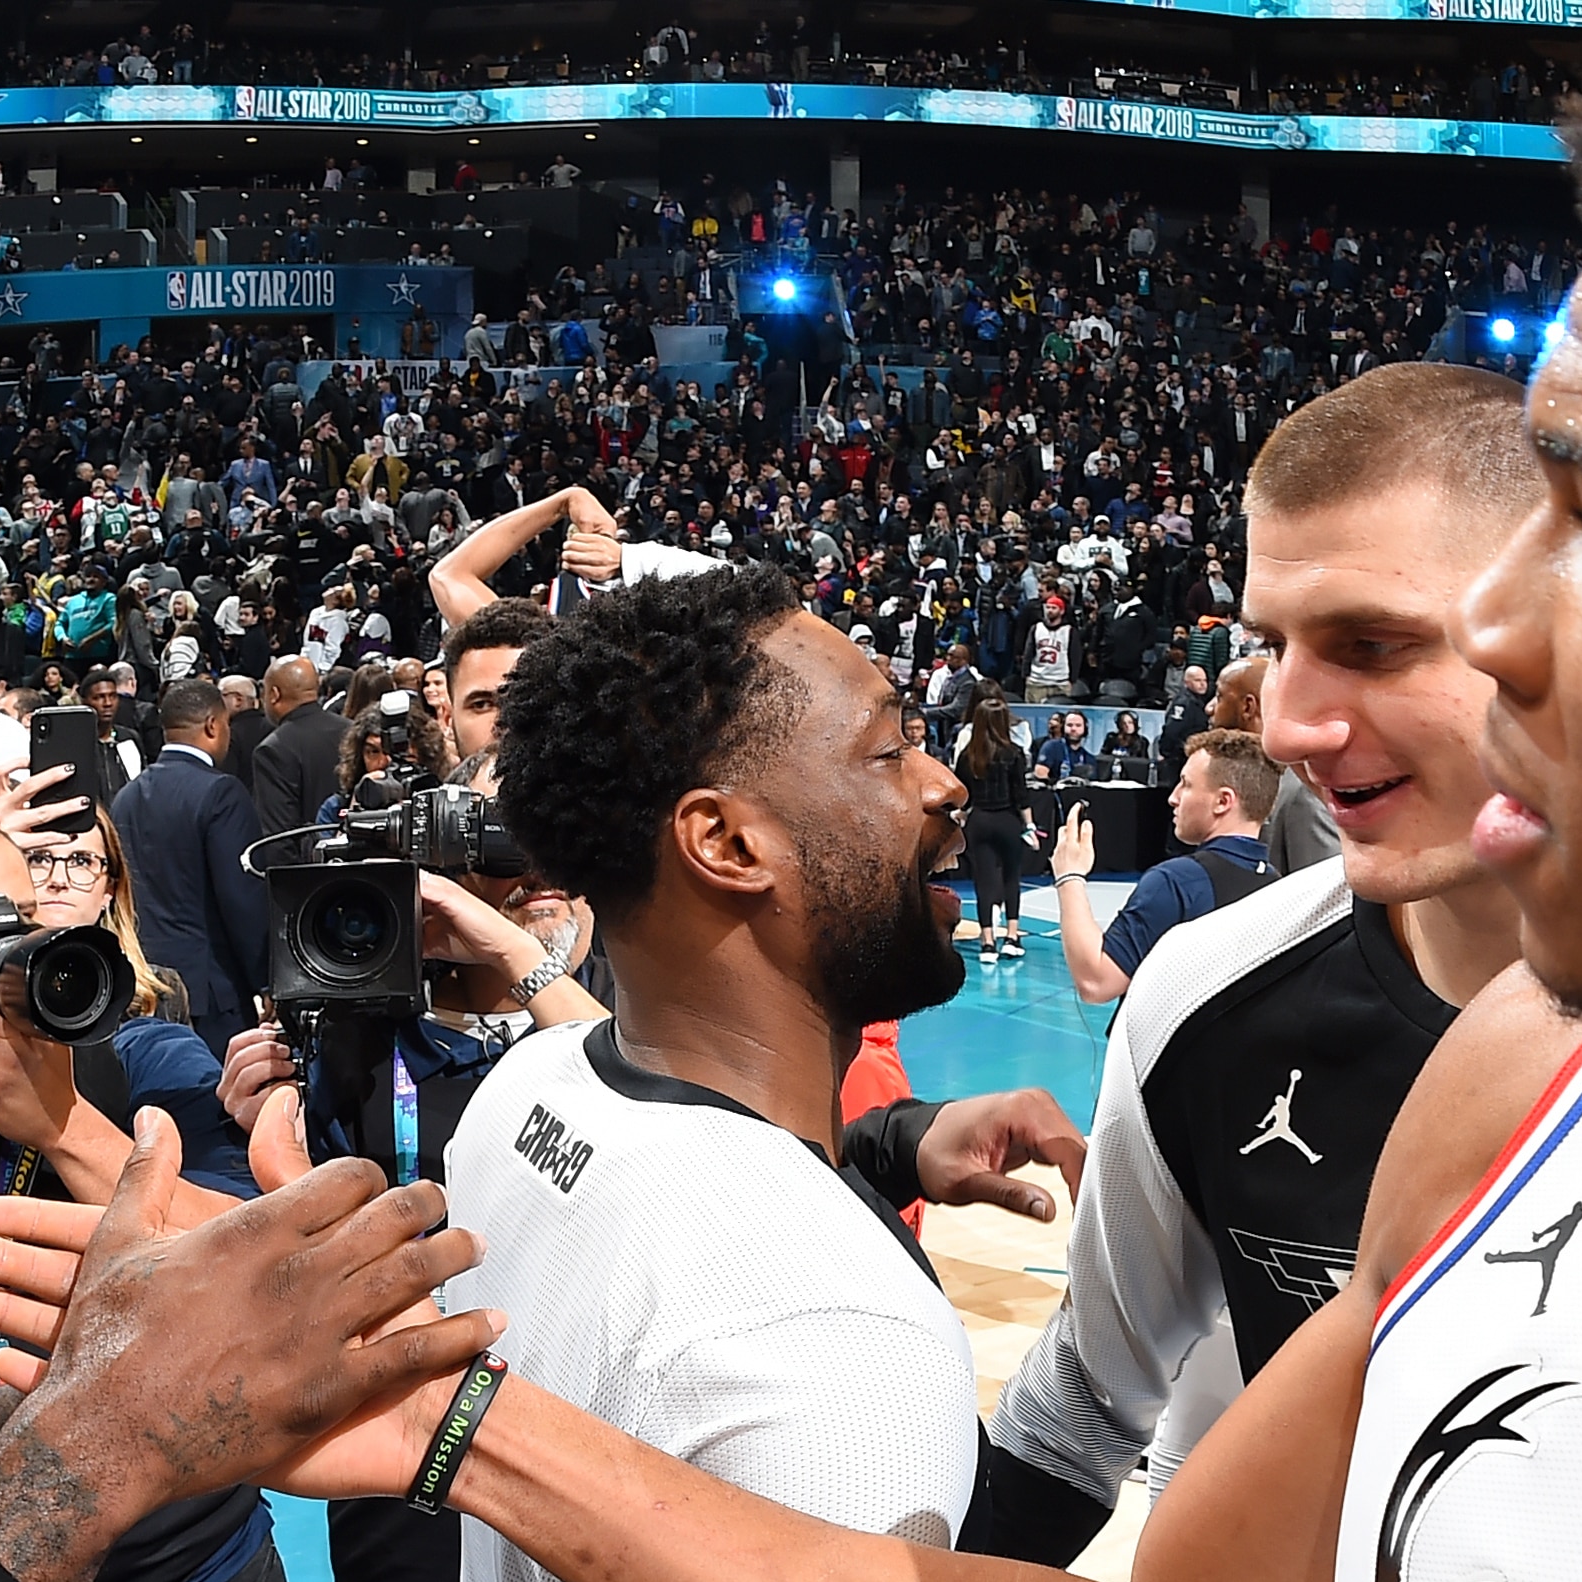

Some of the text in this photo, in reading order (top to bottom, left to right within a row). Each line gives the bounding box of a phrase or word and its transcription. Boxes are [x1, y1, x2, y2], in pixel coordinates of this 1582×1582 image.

[1525, 0, 1563, 23] 2019
[334, 91, 370, 120] 2019
[377, 102, 444, 114] CHARLOTTE
[1154, 110, 1192, 139] 2019
[1200, 122, 1268, 137] CHARLOTTE
[289, 270, 335, 307] 2019
[1039, 650, 1057, 664] 23
[468, 1370, 492, 1397] On
[459, 1399, 474, 1412] a
[421, 1414, 469, 1494] Mission
